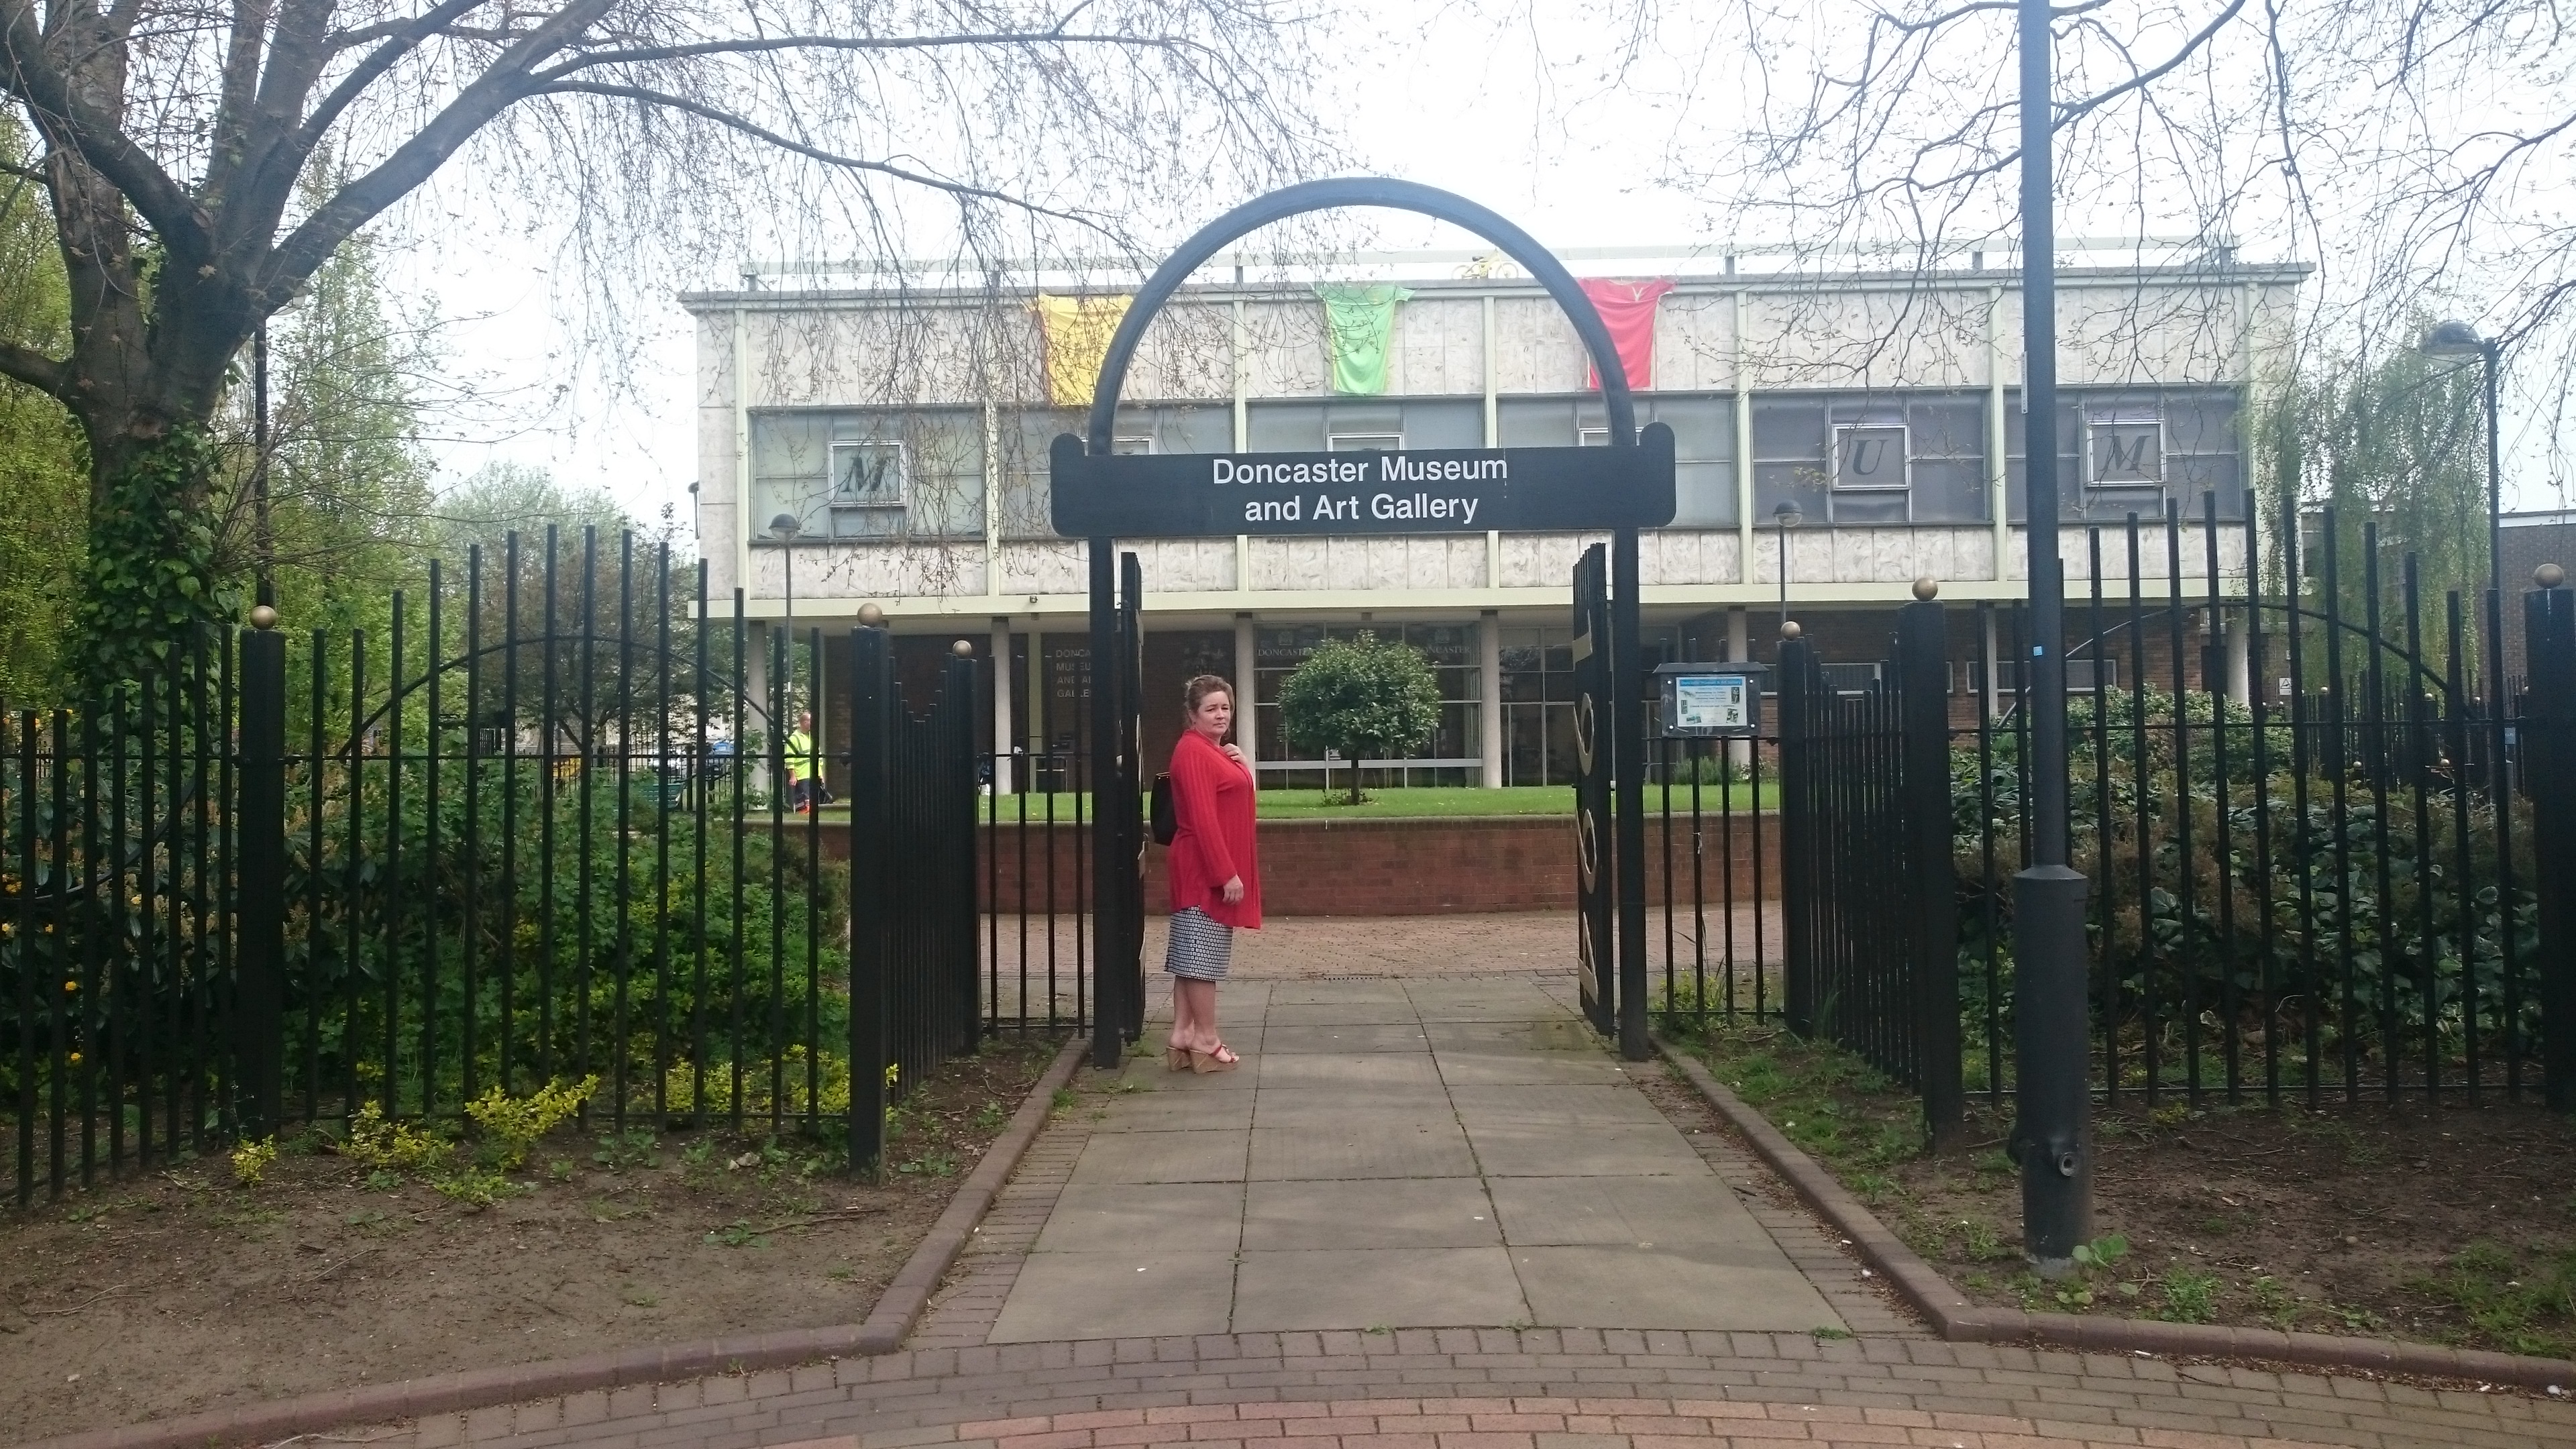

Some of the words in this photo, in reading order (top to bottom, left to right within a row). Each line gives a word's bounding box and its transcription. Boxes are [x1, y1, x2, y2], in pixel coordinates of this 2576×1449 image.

[1213, 458, 1368, 484] Doncaster
[1381, 455, 1507, 481] Museum
[1852, 439, 1889, 475] U
[2099, 435, 2151, 471] M
[1245, 495, 1300, 521] and
[1312, 494, 1359, 520] Art
[1371, 493, 1479, 525] Gallery
